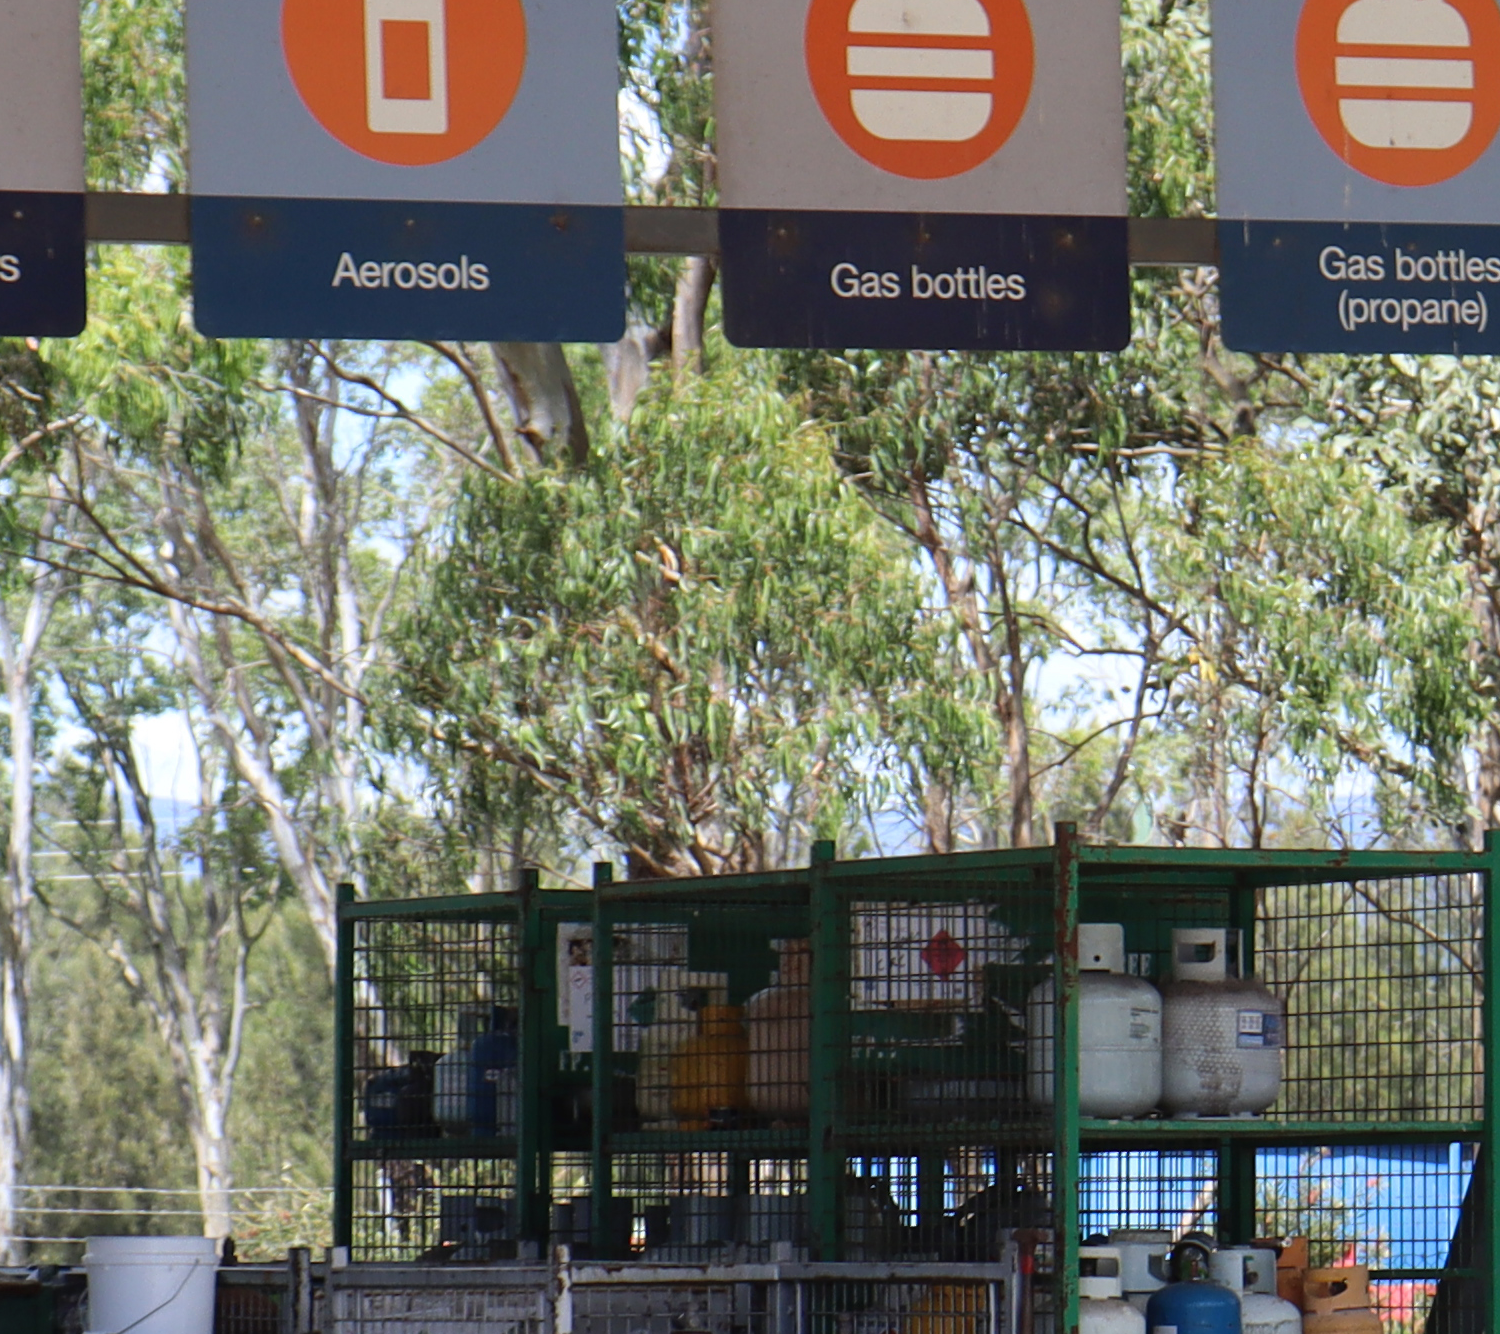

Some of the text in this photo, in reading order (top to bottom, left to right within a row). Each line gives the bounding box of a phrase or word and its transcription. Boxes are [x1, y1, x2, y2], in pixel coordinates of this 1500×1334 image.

[331, 252, 490, 290] Aerosols
[1319, 245, 1385, 280] Gas
[831, 263, 1026, 300] Gas bottles
[1339, 289, 1488, 333] (propane)
